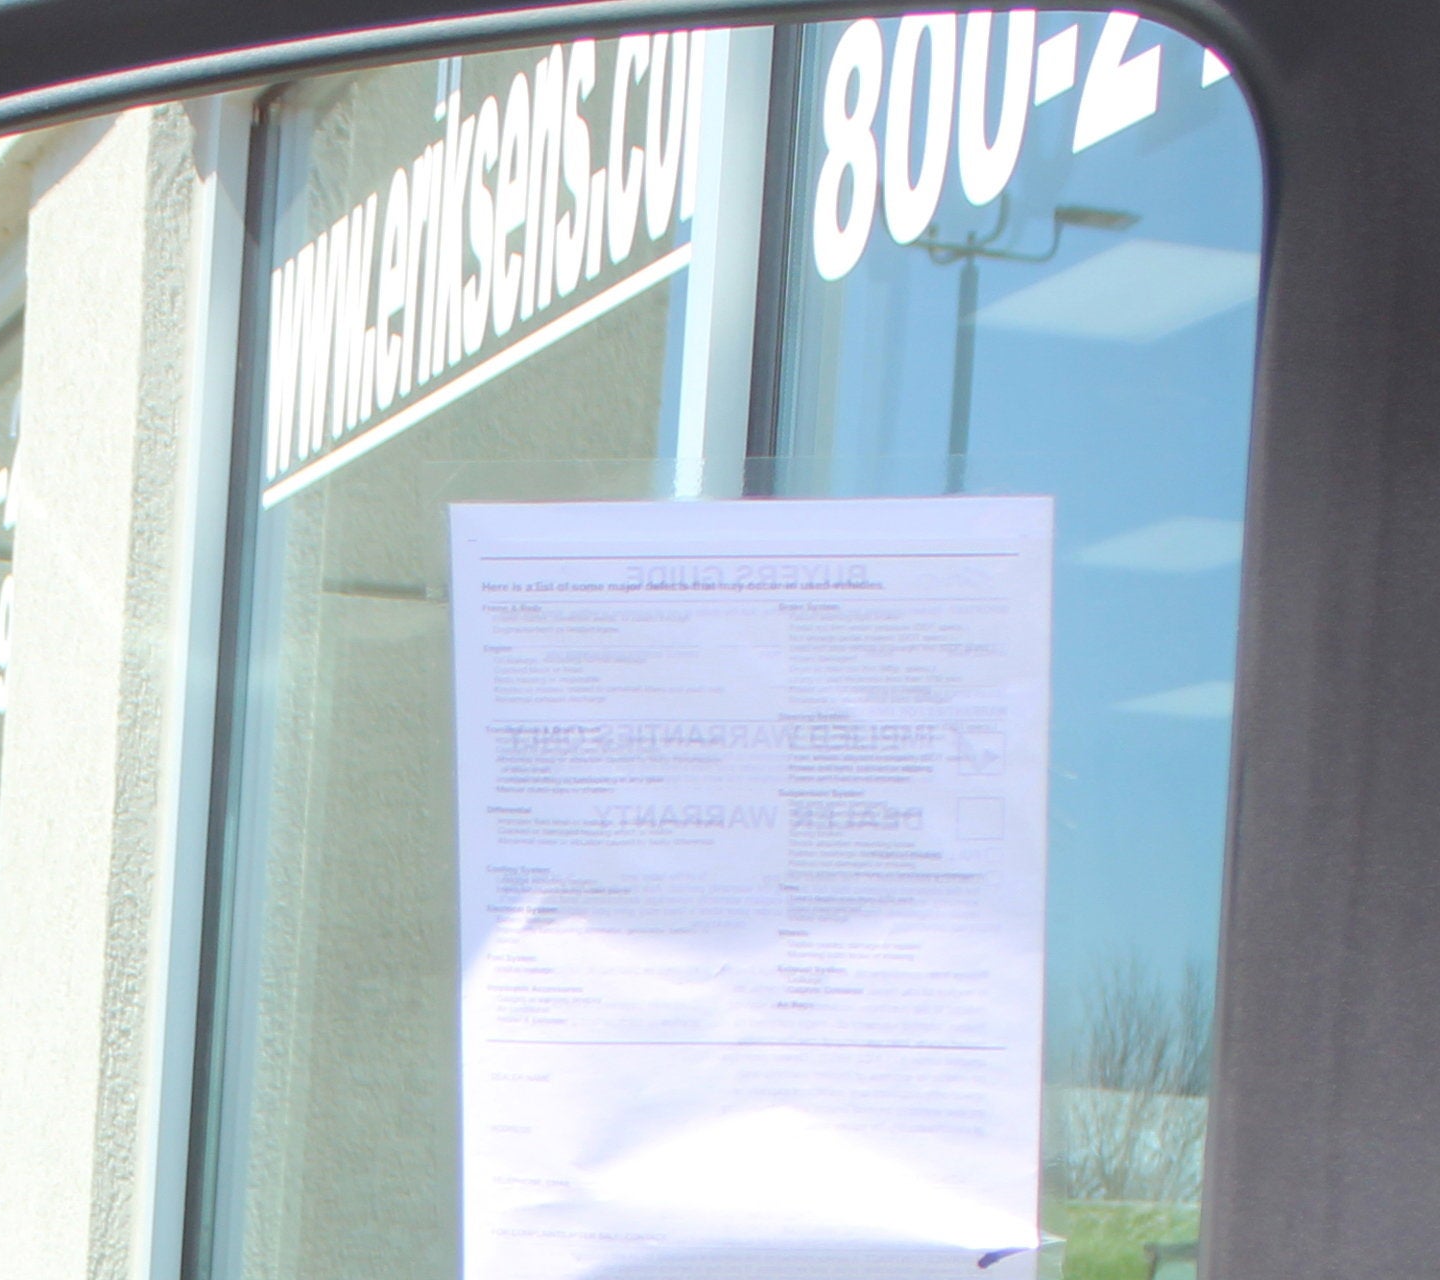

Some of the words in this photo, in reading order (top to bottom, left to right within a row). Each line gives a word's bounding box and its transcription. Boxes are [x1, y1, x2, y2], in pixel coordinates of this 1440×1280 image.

[266, 30, 698, 482] www.eriksens.co
[814, 9, 1231, 281] 800-2
[482, 582, 509, 591] Here
[512, 582, 522, 591] is
[557, 582, 570, 591] of
[608, 582, 642, 594] major
